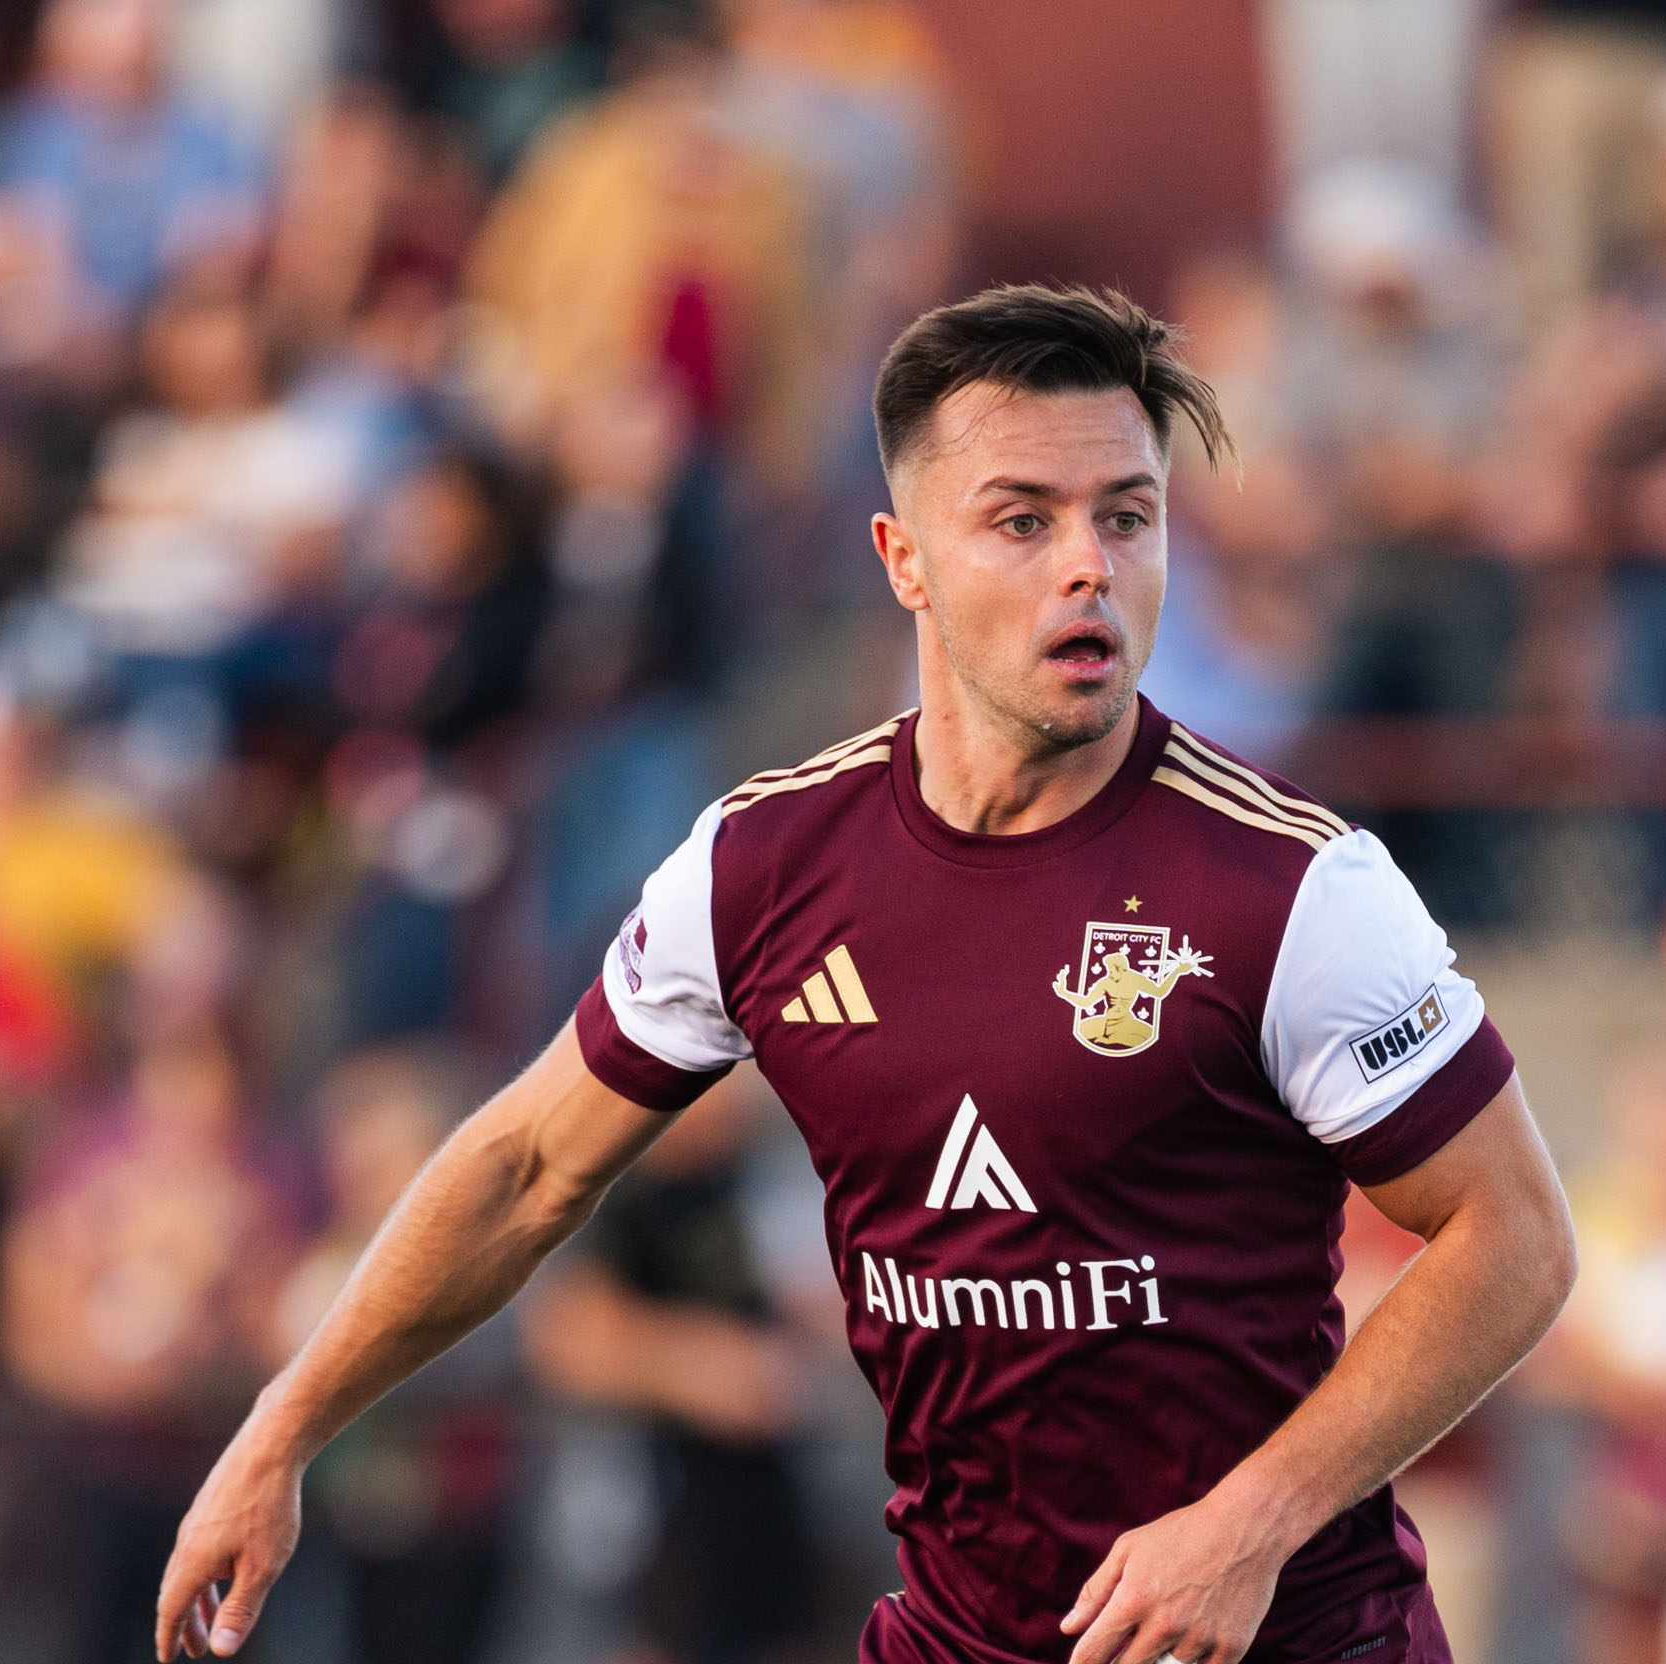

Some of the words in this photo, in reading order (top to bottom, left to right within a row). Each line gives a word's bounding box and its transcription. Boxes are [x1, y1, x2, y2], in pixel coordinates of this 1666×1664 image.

[1093, 931, 1128, 942] DETROIT
[1129, 934, 1149, 943] CITY
[1150, 935, 1162, 945] FC
[1359, 1017, 1426, 1070] USL
[862, 1251, 1169, 1330] AlumniFi
